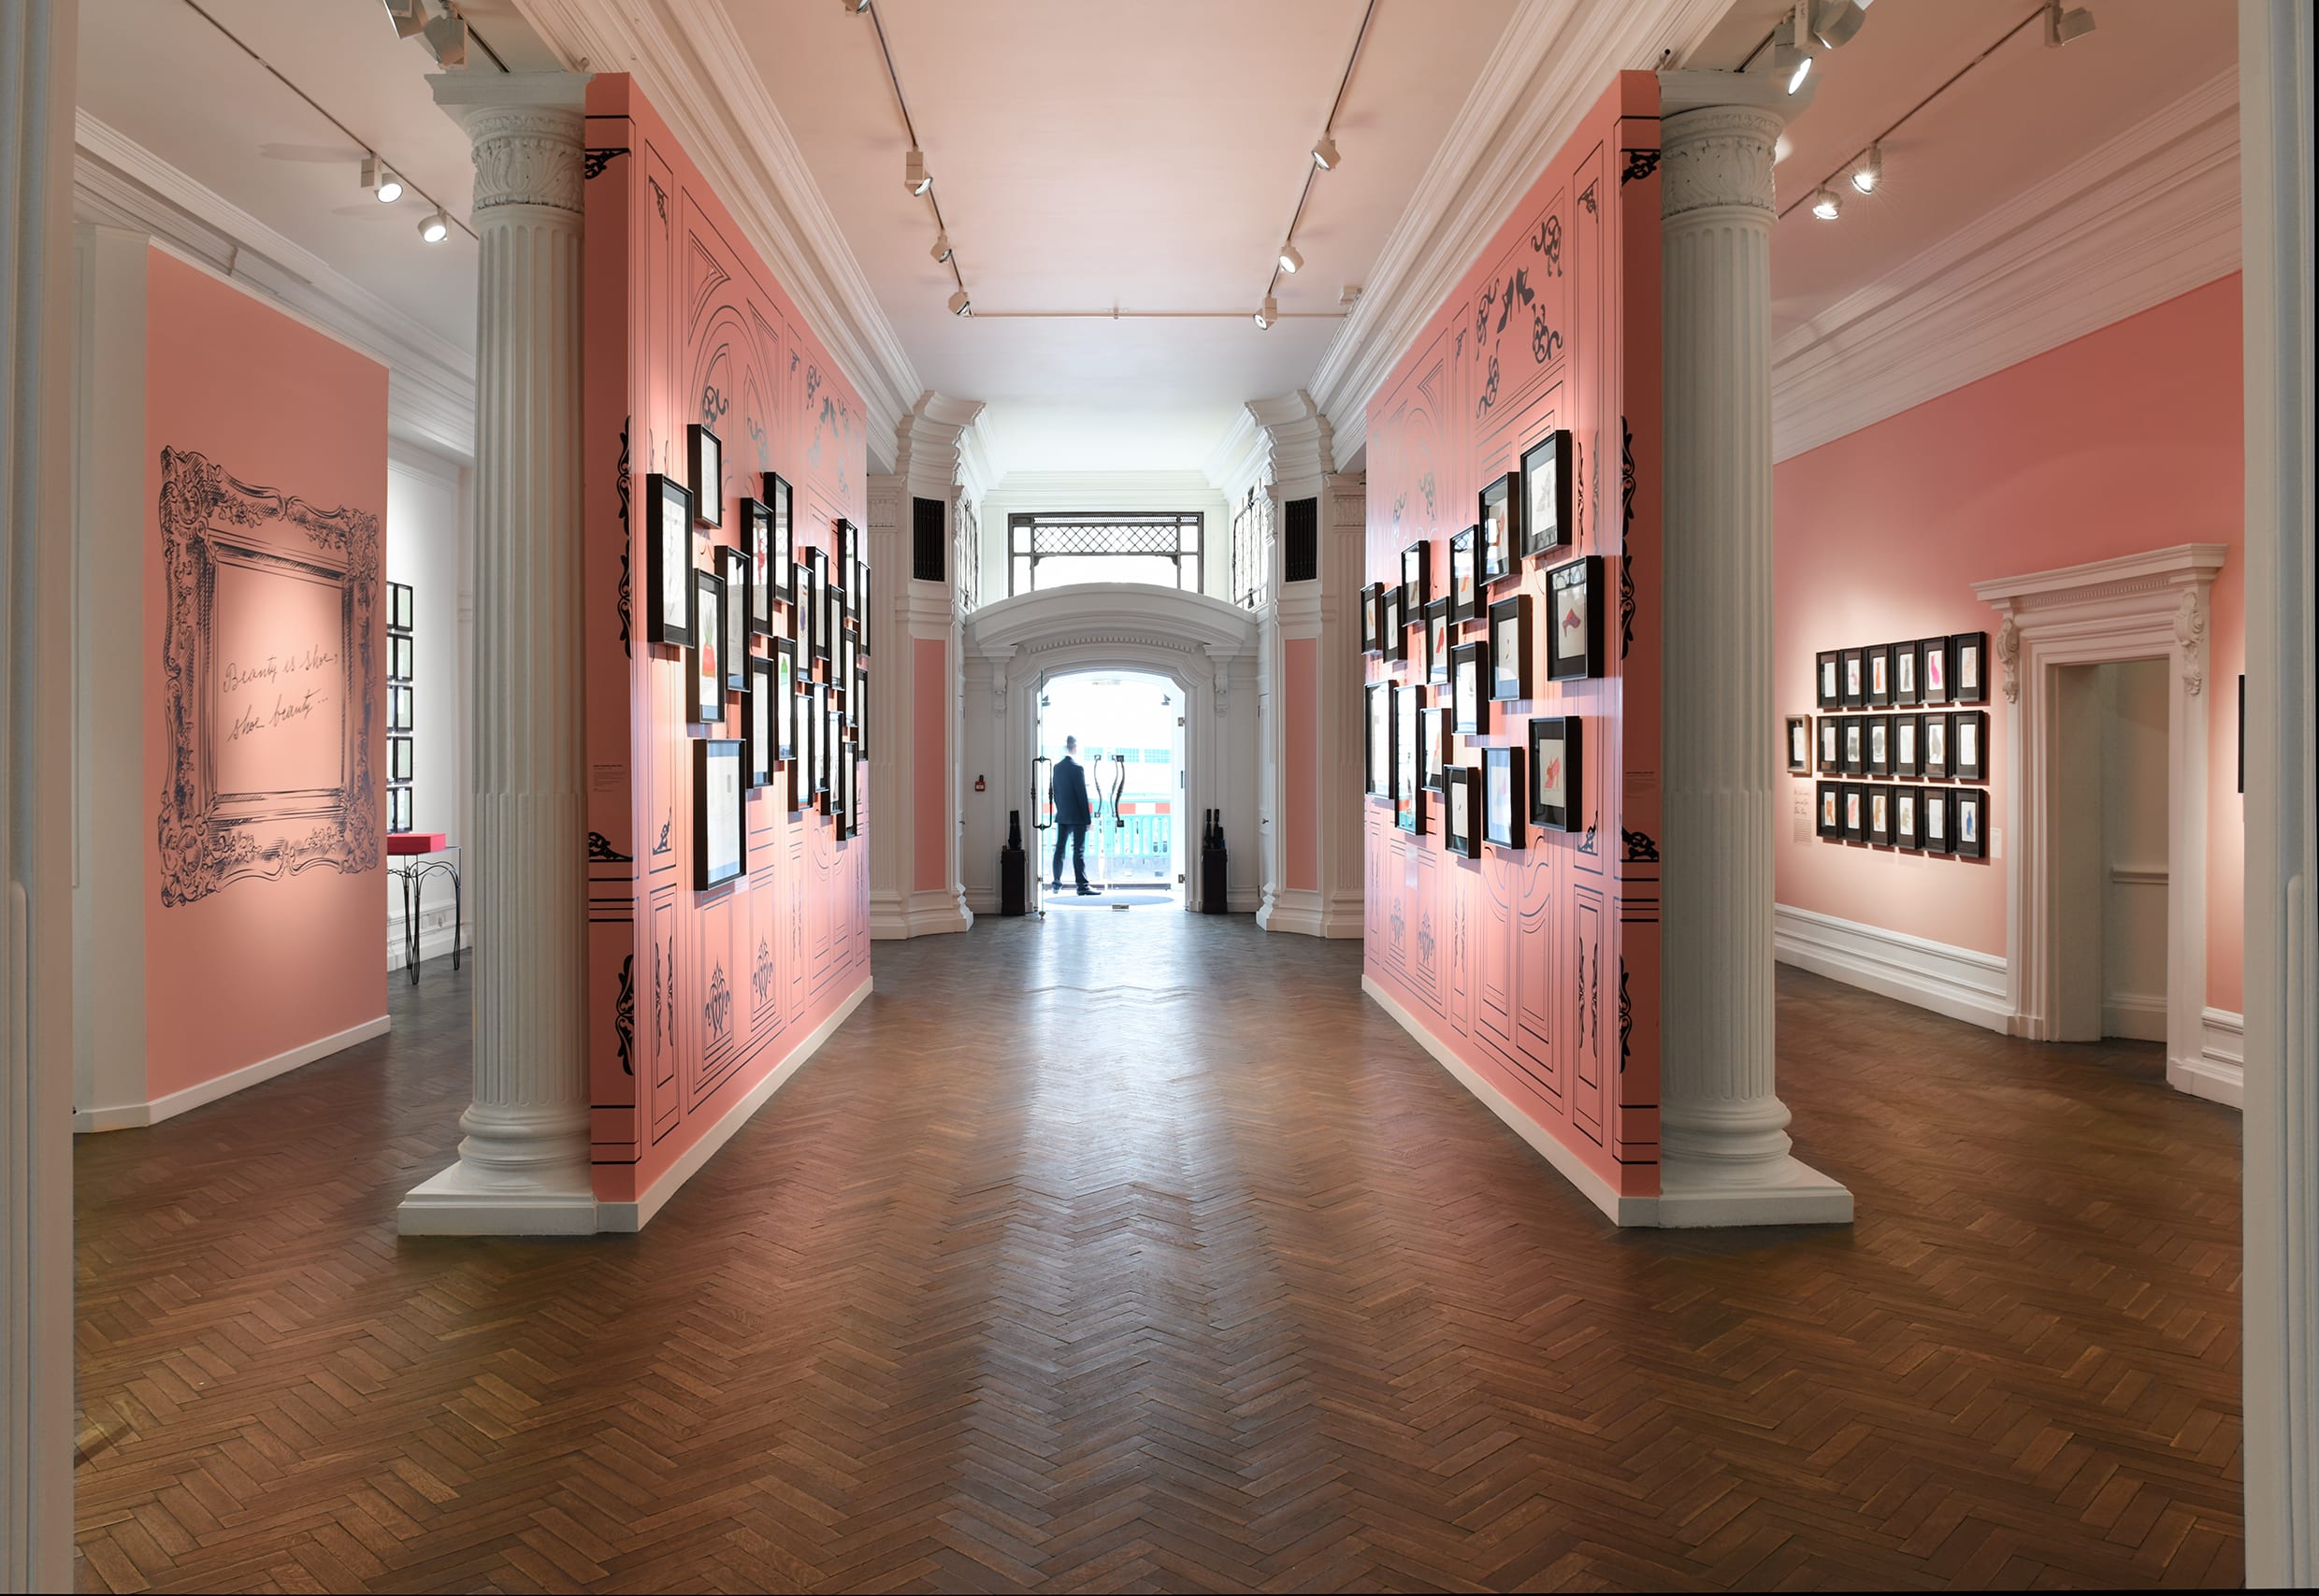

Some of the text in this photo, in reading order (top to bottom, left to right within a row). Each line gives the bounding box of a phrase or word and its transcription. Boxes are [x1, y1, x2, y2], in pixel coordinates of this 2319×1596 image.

[223, 655, 278, 694] Beauty
[283, 655, 295, 674] is
[226, 704, 266, 742] shoe
